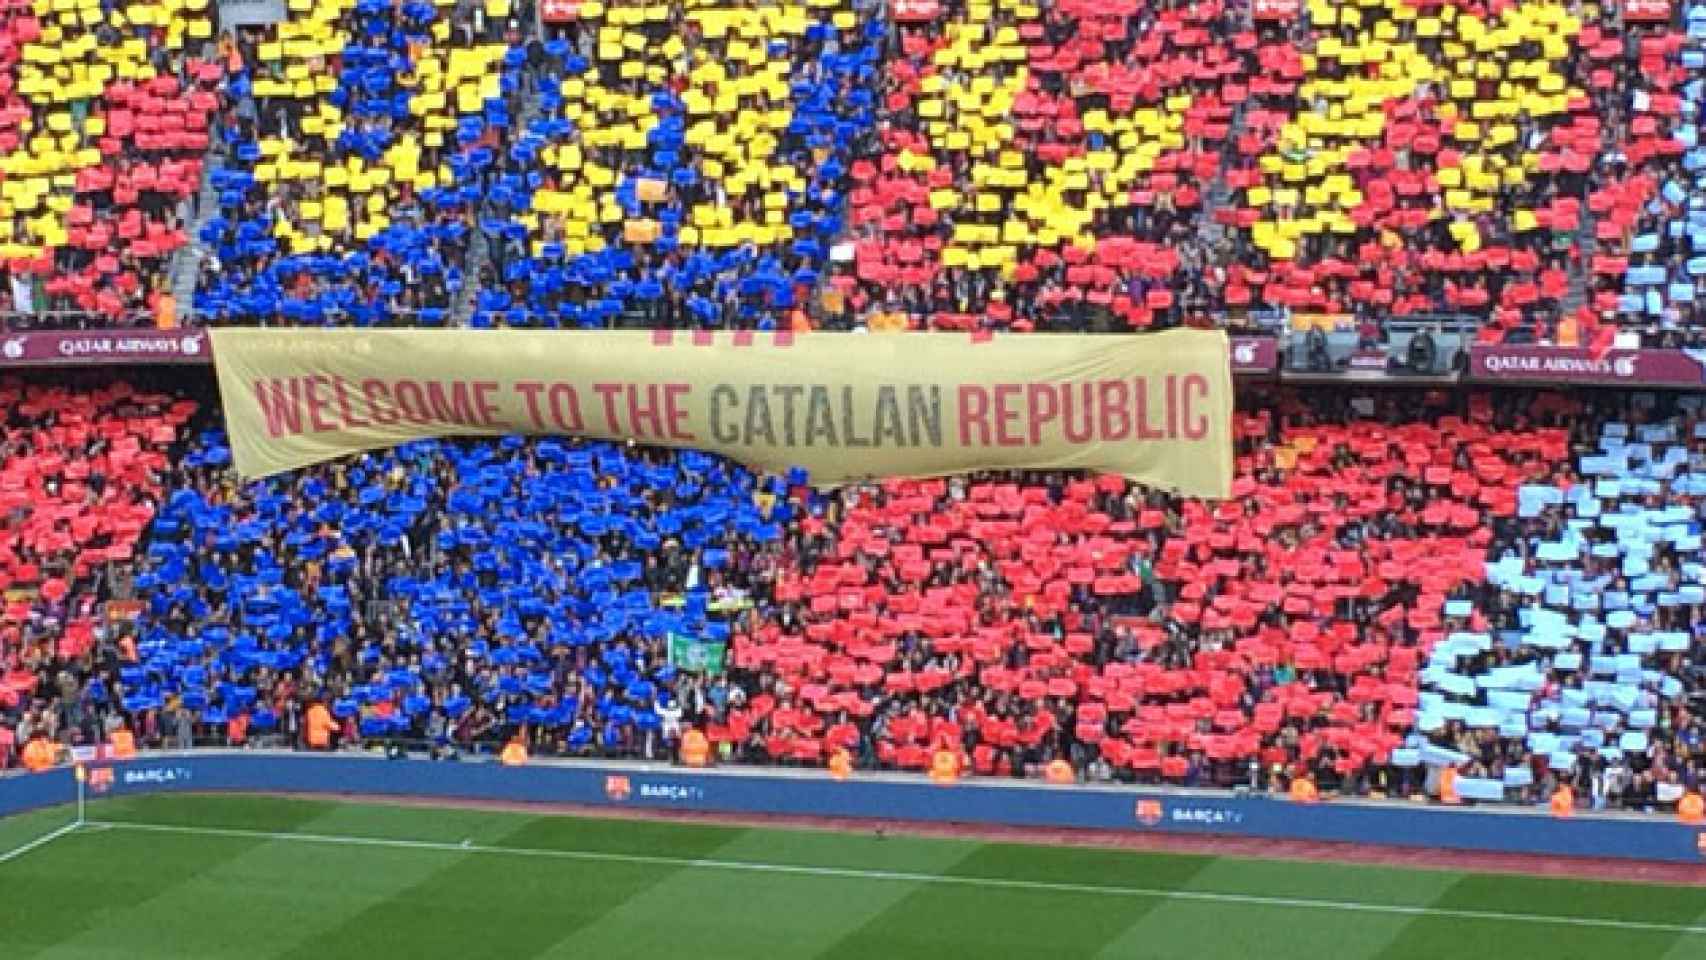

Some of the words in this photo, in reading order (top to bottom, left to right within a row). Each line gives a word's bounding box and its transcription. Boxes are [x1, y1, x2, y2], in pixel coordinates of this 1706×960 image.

[60, 337, 112, 355] QATAR
[1485, 356, 1539, 371] QATAR
[254, 374, 512, 438] WELCOME
[515, 382, 585, 431] TO
[593, 382, 696, 442] THE
[709, 383, 942, 448] CATALAN
[958, 373, 1209, 447] REPUBLIC
